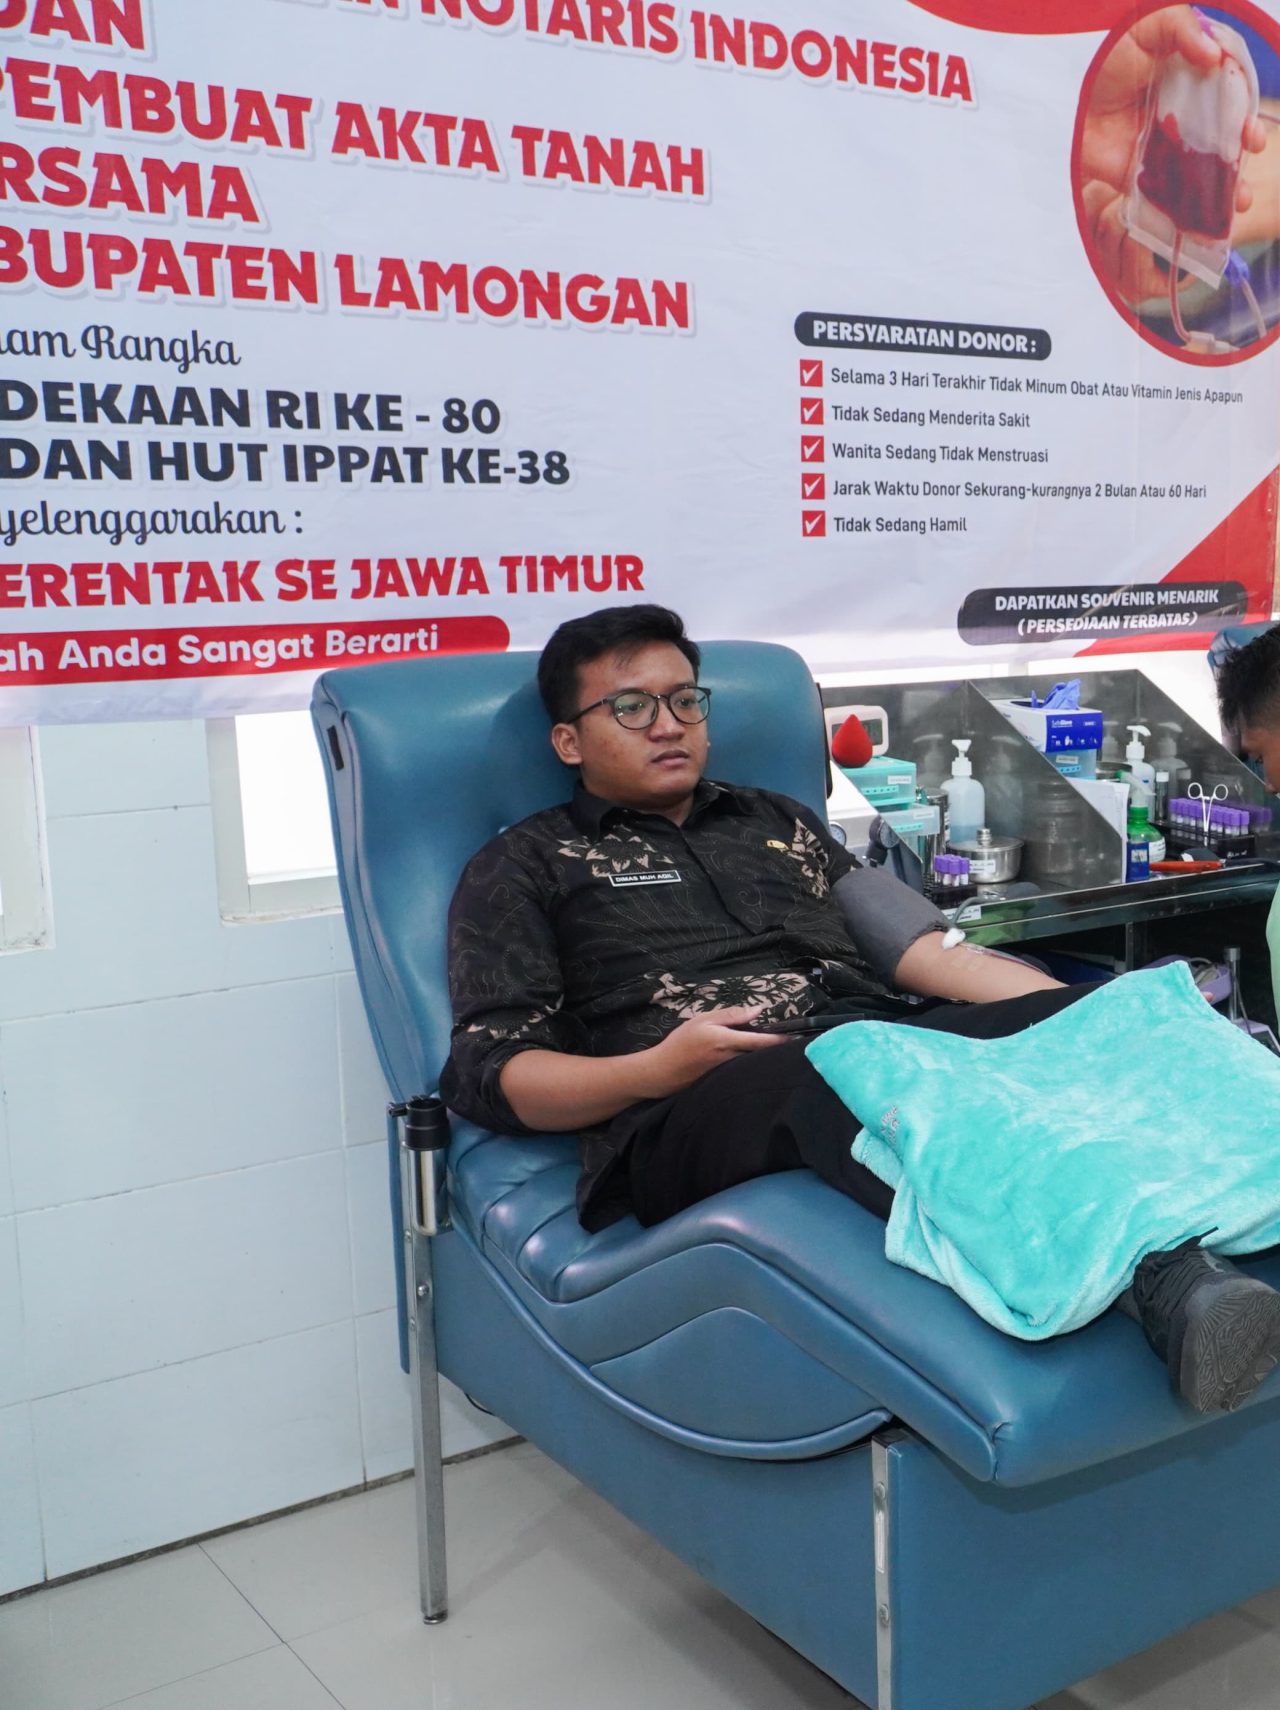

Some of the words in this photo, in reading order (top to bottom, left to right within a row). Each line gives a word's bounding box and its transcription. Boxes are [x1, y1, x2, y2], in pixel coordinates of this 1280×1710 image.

[0, 0, 145, 51] AN
[690, 11, 972, 101] INDONESIA
[0, 57, 313, 150] EMBUAT
[331, 101, 500, 173] AKTA
[511, 125, 705, 196] TANAH
[334, 253, 689, 329] LAMONGAN
[80, 325, 242, 374] Rangka
[813, 319, 954, 348] PERSYARATAN
[831, 367, 885, 386] Selama
[889, 371, 897, 386] 3
[902, 371, 929, 388] Hari
[932, 372, 986, 390] Terakhir
[988, 376, 1023, 393] Tidak
[1026, 378, 1067, 394] Minum
[1071, 380, 1099, 396] Obat
[1102, 382, 1129, 398] Atau
[1131, 383, 1172, 400] Vitamin
[1174, 387, 1201, 401] Jenis
[1204, 388, 1243, 405] Apapun
[266, 390, 320, 430] RI
[334, 393, 403, 432] KE
[442, 398, 501, 434] 80
[832, 405, 869, 421] Tidak
[874, 407, 925, 426] Sedang
[929, 409, 995, 427] Menderita
[998, 412, 1030, 428] Sakit
[0, 438, 133, 482] DAN
[148, 441, 268, 482] HUT
[283, 443, 429, 483] IPPAT
[441, 447, 571, 485] KE-38
[832, 442, 882, 459] Wanita
[885, 444, 937, 463] Sedang
[939, 445, 974, 461] Tidak
[978, 447, 1049, 463] Menstruasi
[833, 480, 871, 496] Jarak
[874, 480, 919, 496] Waktu
[923, 481, 961, 497] Donor
[964, 481, 1092, 500] Sekurang-kurangnya
[1095, 484, 1101, 497] 2
[1105, 484, 1137, 498] Bulan
[1140, 484, 1166, 498] Atau
[1168, 485, 1182, 498] 60
[1185, 485, 1207, 498] Hari
[833, 517, 871, 533] Tidak
[875, 516, 927, 535] Sedang
[930, 516, 968, 532] Hamil
[275, 558, 337, 602] SE
[351, 557, 490, 599] JAWA
[499, 554, 645, 593] TIMUR
[995, 594, 1079, 611] DAPATKAN
[1081, 590, 1155, 608] SOUVENIR
[1157, 589, 1220, 606] MENARIK
[1122, 610, 1198, 630] TERBATAS)
[58, 637, 166, 670] Anda
[178, 633, 314, 667] Sangat
[325, 624, 438, 656] Berarti
